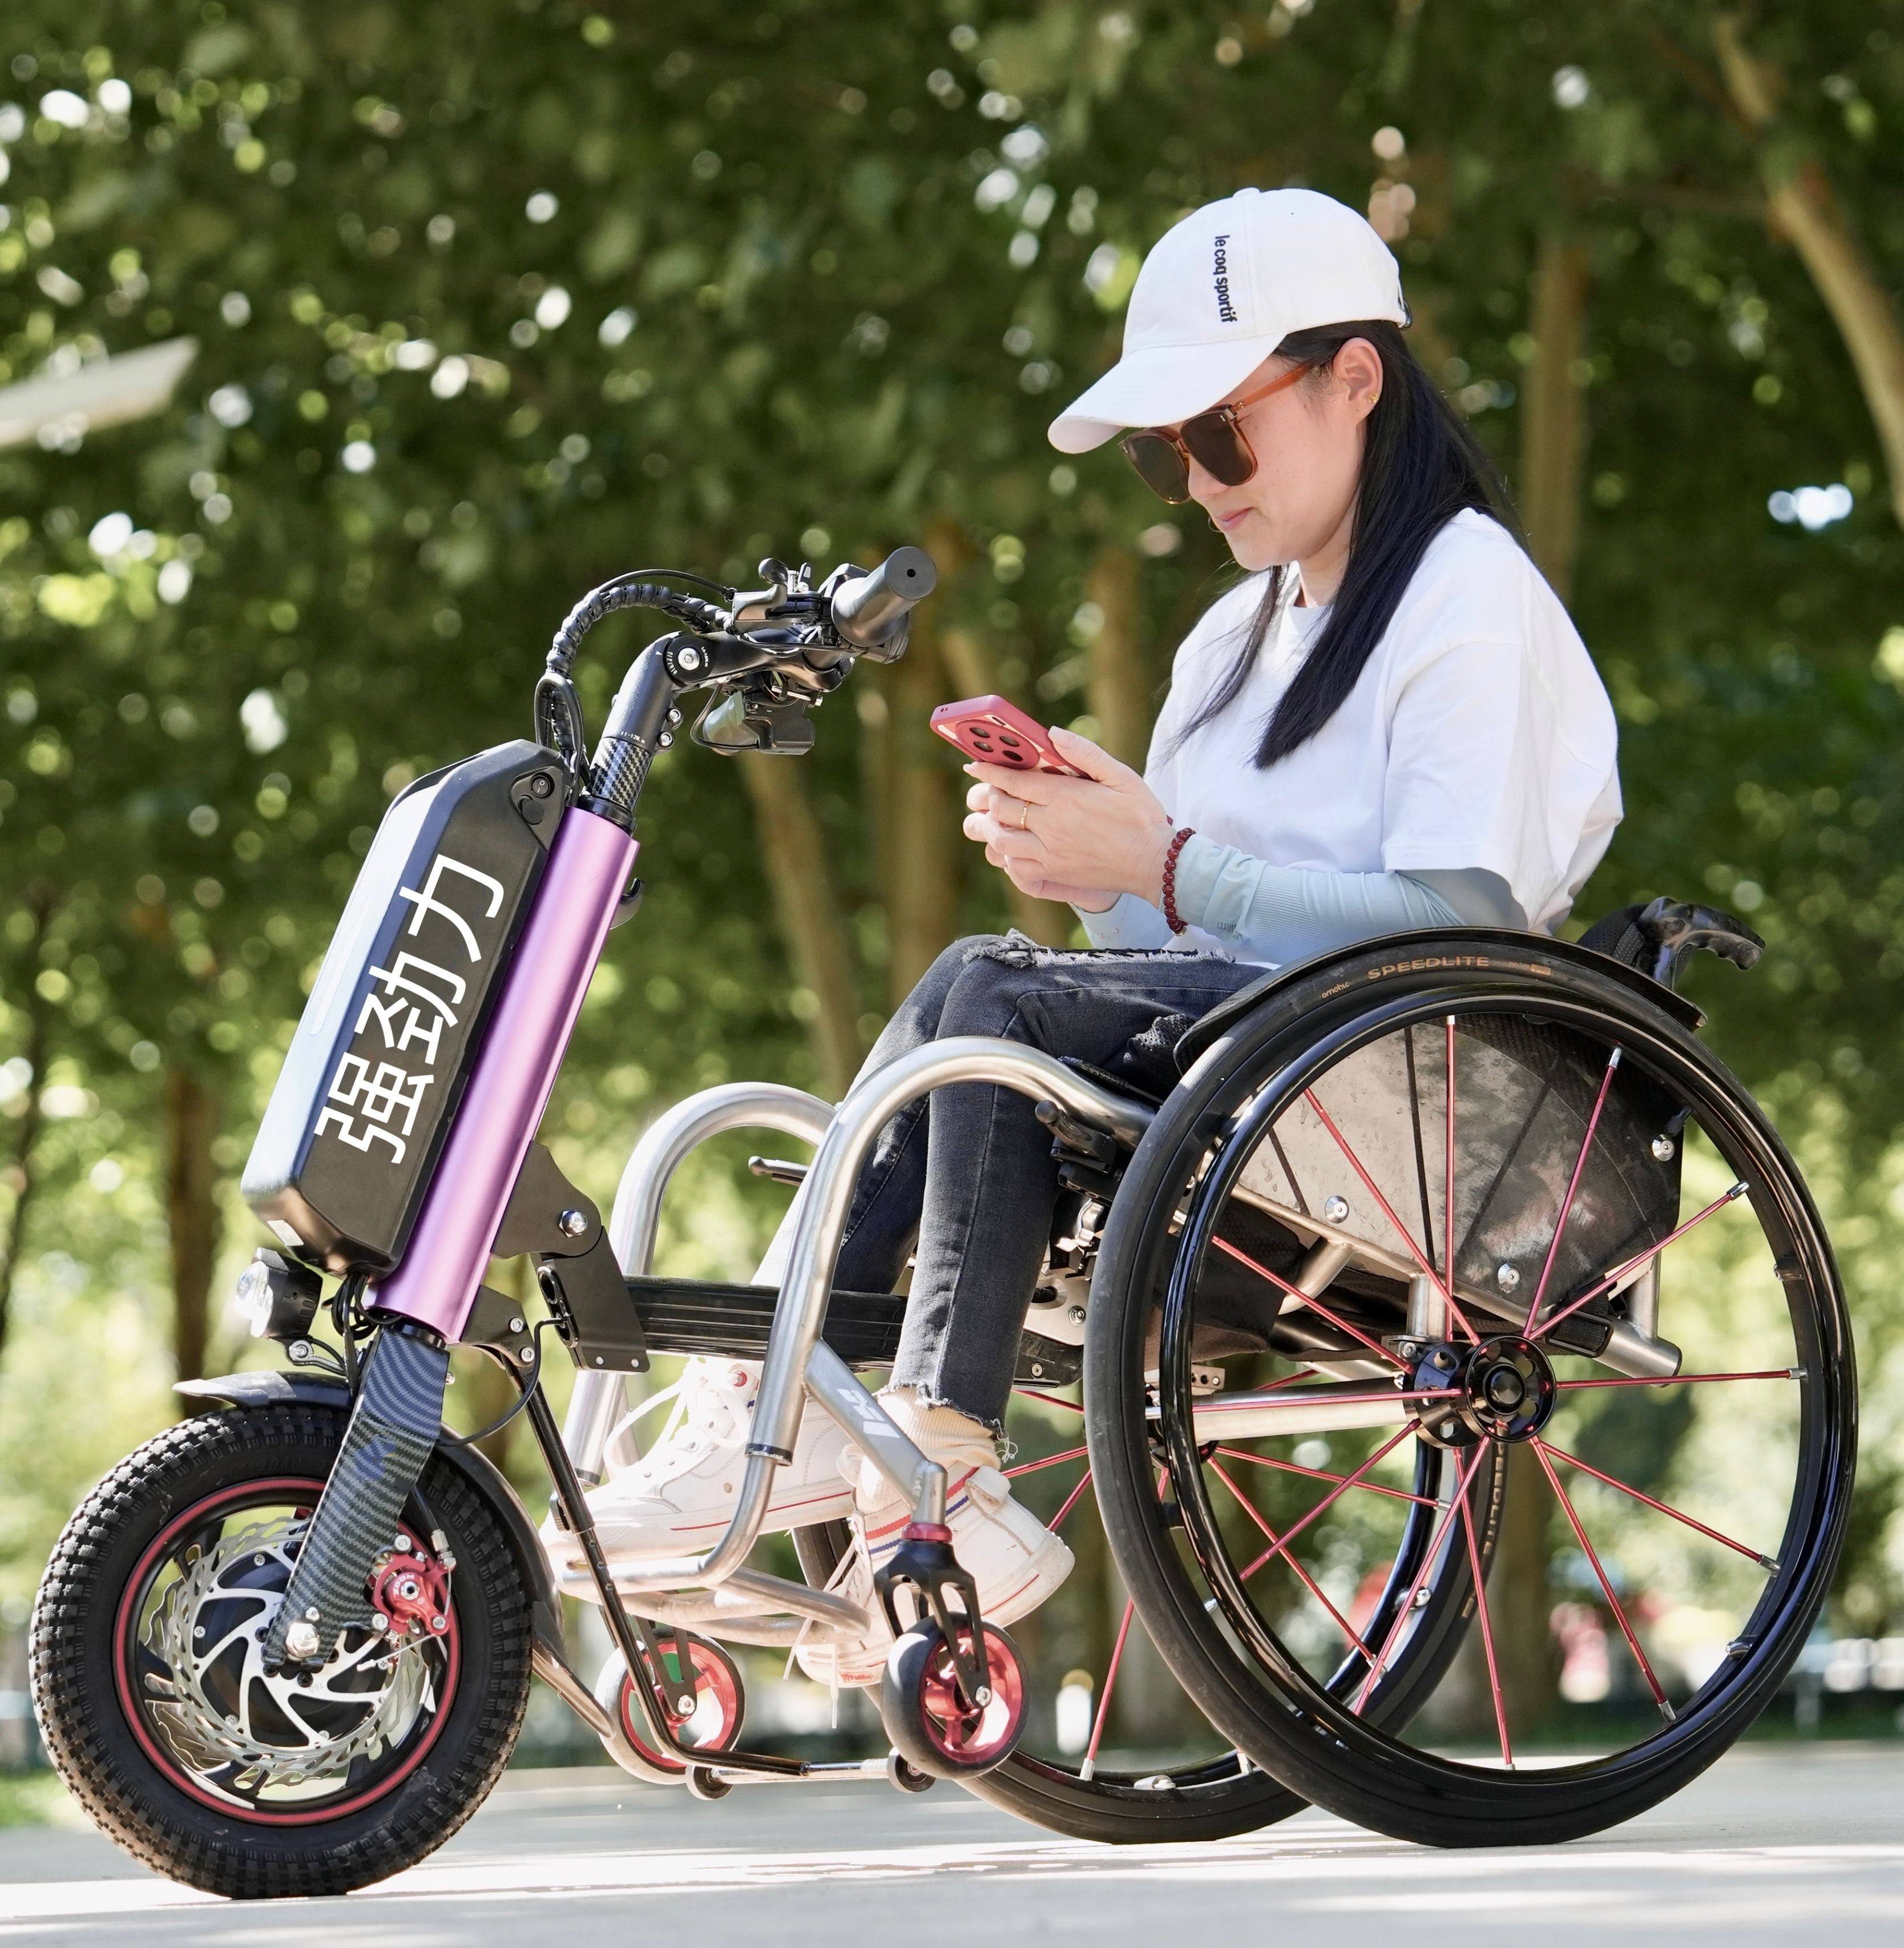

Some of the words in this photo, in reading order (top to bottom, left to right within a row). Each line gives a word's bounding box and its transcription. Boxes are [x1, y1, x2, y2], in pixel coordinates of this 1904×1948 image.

[1215, 235, 1230, 247] le
[1213, 249, 1227, 275] coq
[1213, 277, 1237, 322] sportif
[1368, 956, 1490, 979] SPEEDLITE
[314, 854, 505, 1164] 强劲力
